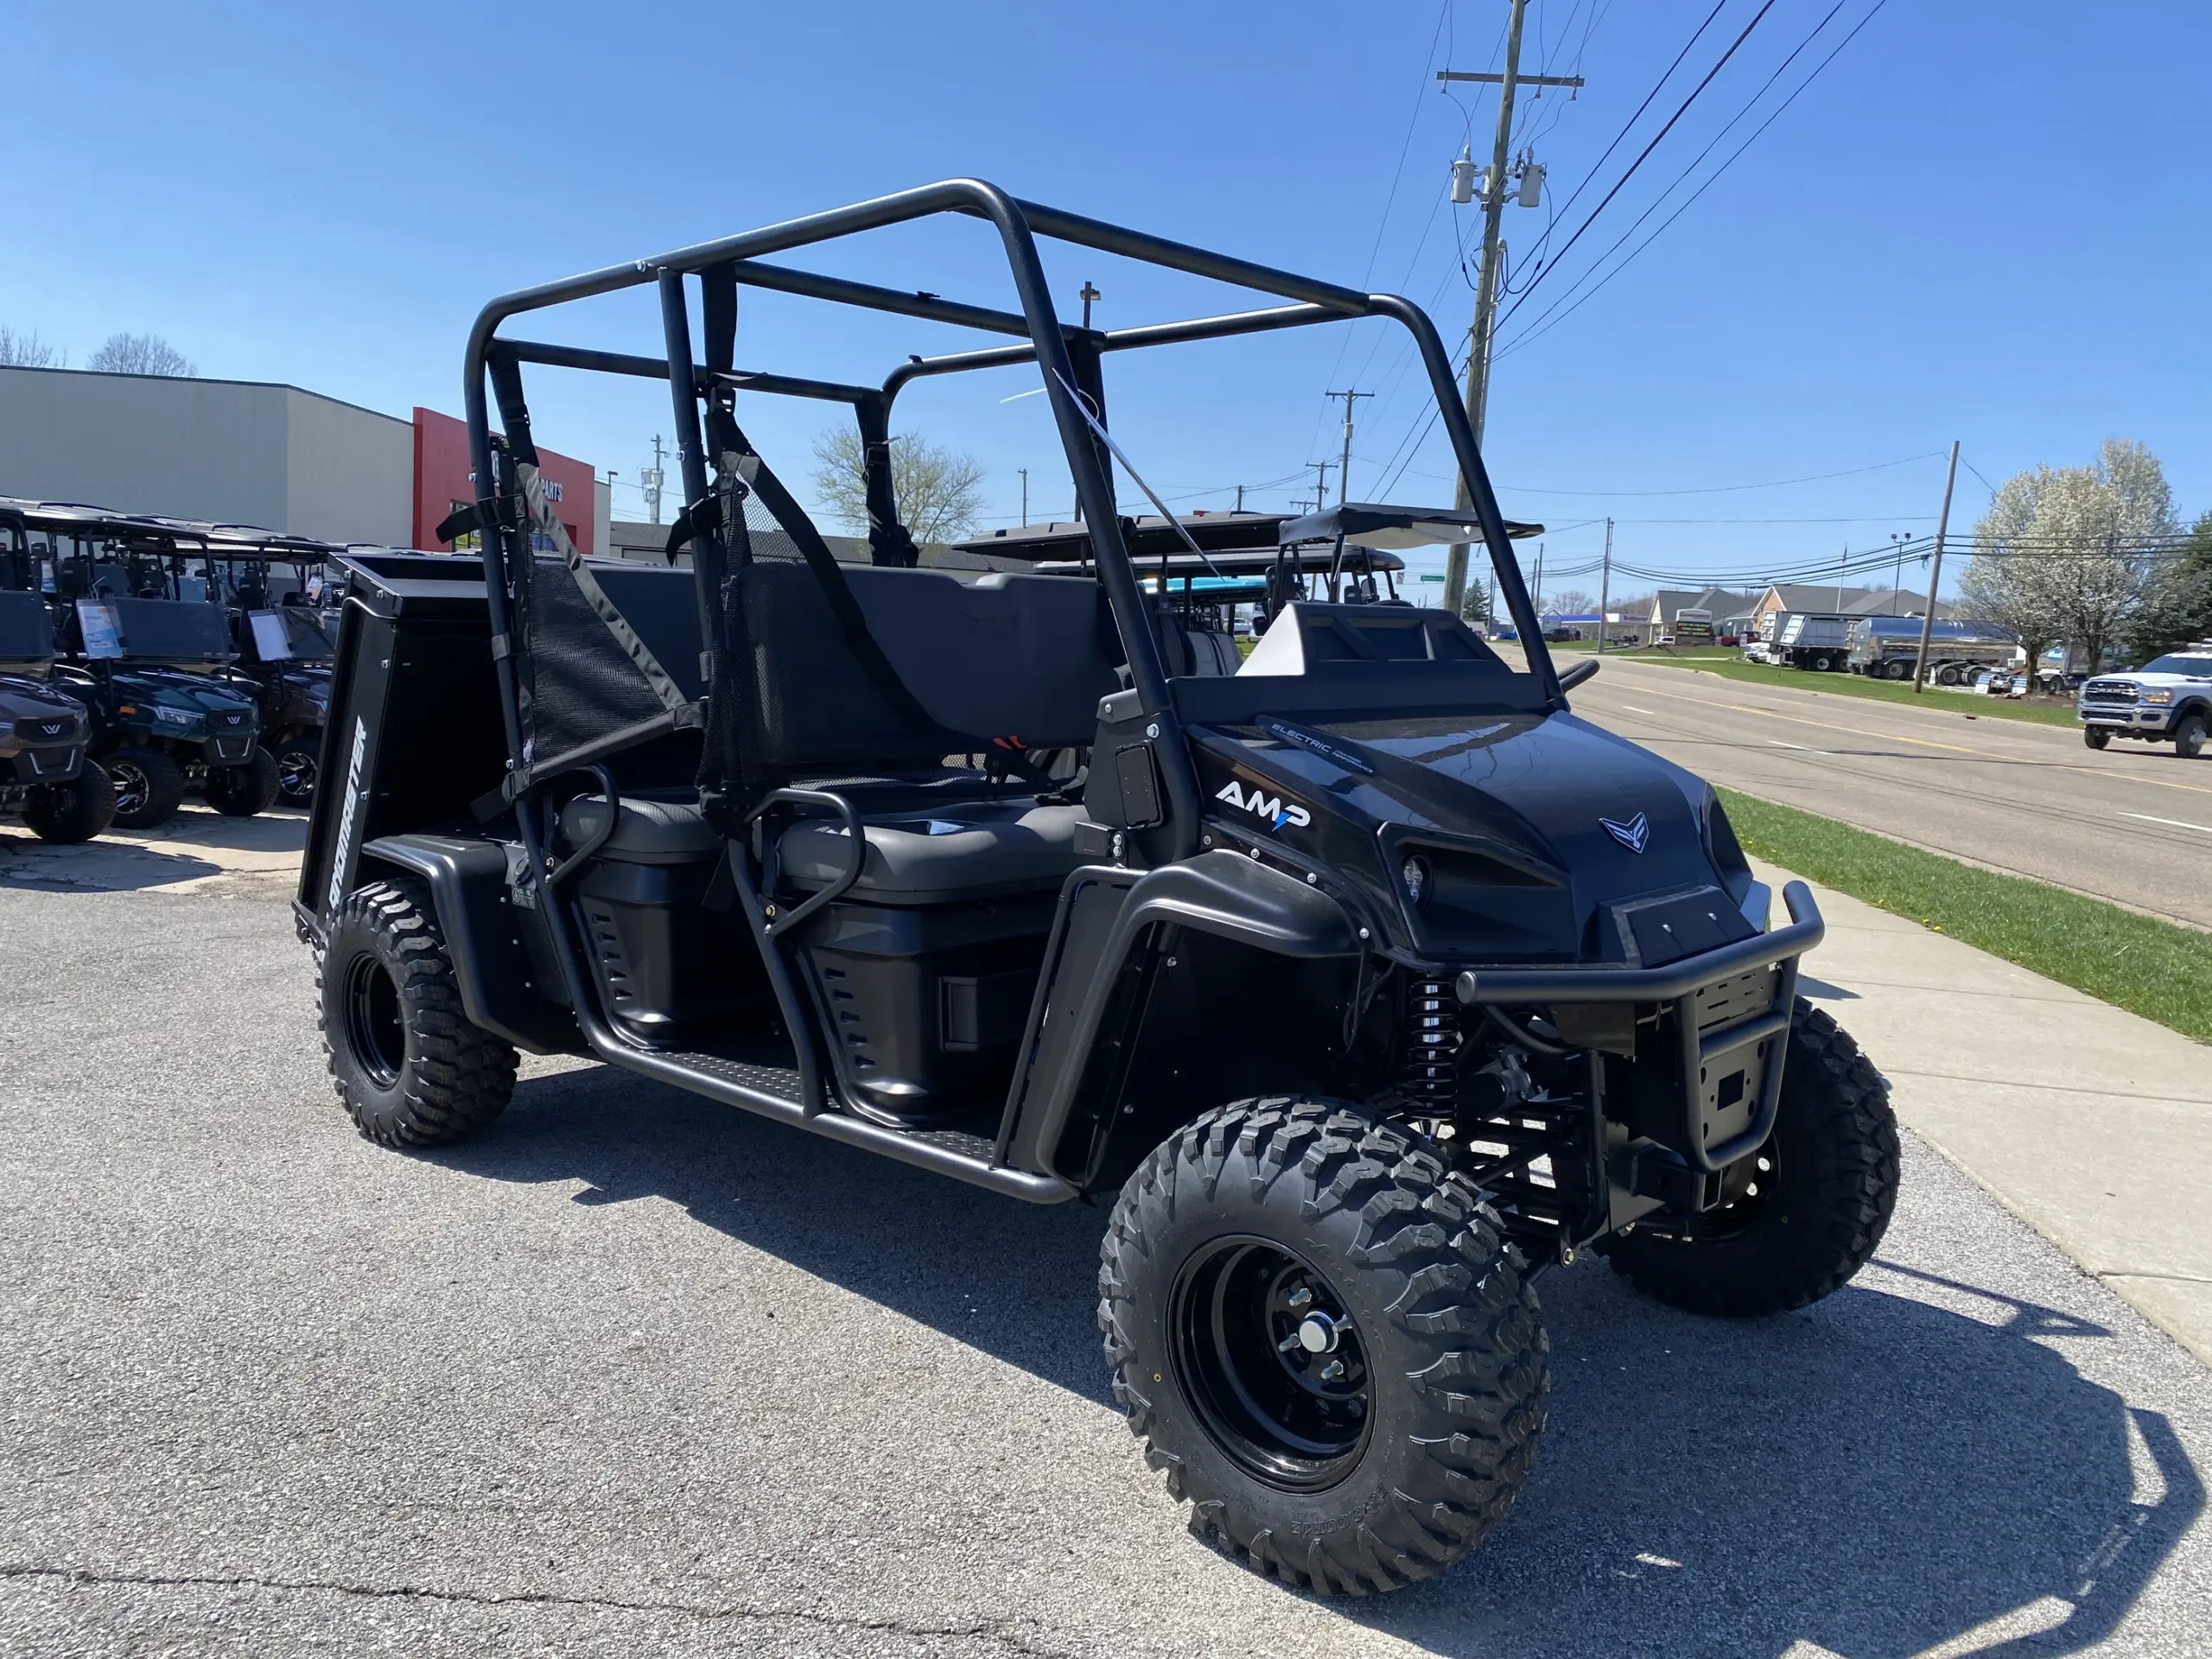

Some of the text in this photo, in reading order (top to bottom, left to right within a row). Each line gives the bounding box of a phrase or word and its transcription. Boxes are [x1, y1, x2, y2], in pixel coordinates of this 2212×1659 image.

[1271, 723, 1332, 753] ELECTRIC
[1332, 752, 1374, 773] PERFORMANCE
[328, 714, 367, 909] ANDMASTER
[1215, 780, 1311, 836] AMP
